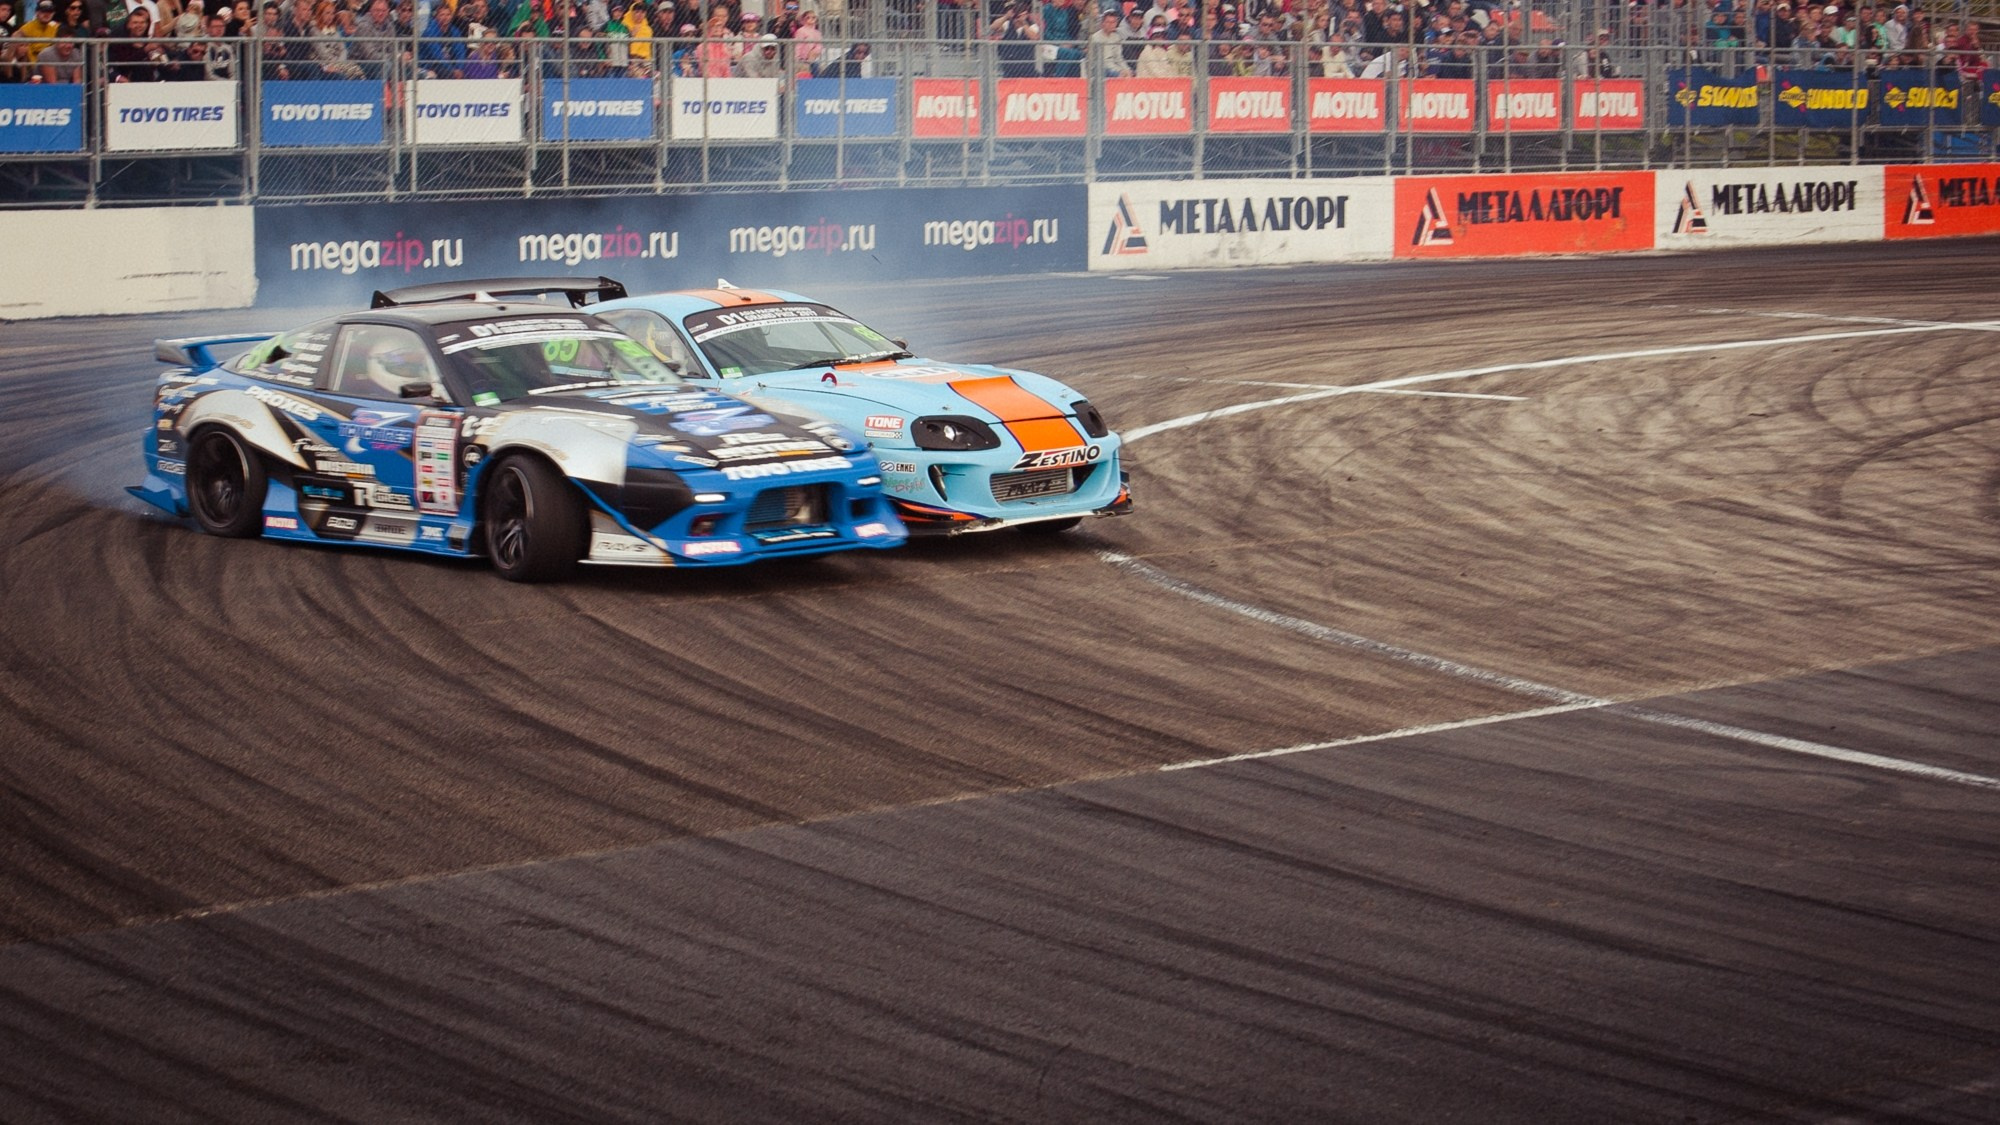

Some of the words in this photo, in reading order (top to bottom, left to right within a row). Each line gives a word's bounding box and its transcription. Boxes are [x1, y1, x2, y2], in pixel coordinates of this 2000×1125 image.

[15, 108, 72, 126] TIRES
[119, 108, 169, 124] TOYO
[172, 106, 225, 122] TIRES
[271, 103, 321, 121] TOYO
[321, 103, 374, 120] TIRES
[417, 103, 460, 118] TOYO
[464, 103, 511, 118] TIRES
[551, 100, 599, 117] TOYO
[598, 100, 645, 116] TIRES
[726, 100, 768, 114] TIRES
[845, 98, 889, 114] TIRES
[916, 95, 978, 119] MOTUL
[1004, 94, 1081, 122] MOTUL
[1112, 92, 1185, 121] MOTUL
[1215, 92, 1285, 119] MOTUL
[1312, 92, 1379, 119] MOTUL
[1405, 93, 1470, 120] MOTUL
[1495, 93, 1557, 120] MOTUL
[1579, 92, 1638, 118] MOTUL
[1457, 187, 1624, 226] МЕТАЛЛТОРГ
[1712, 180, 1858, 216] МЕТАЛЛТОРГ
[1159, 195, 1349, 235] МЕТАЛЛТОРГ
[518, 225, 679, 266] megazip.ru
[730, 217, 876, 257] megazip.ru
[924, 213, 1058, 251] megazip.ru
[290, 231, 464, 275] megazip.ru
[244, 385, 321, 421] PROXES
[868, 416, 902, 428] TONE
[1013, 446, 1100, 469] ZESTINO
[721, 463, 791, 480] TOYO
